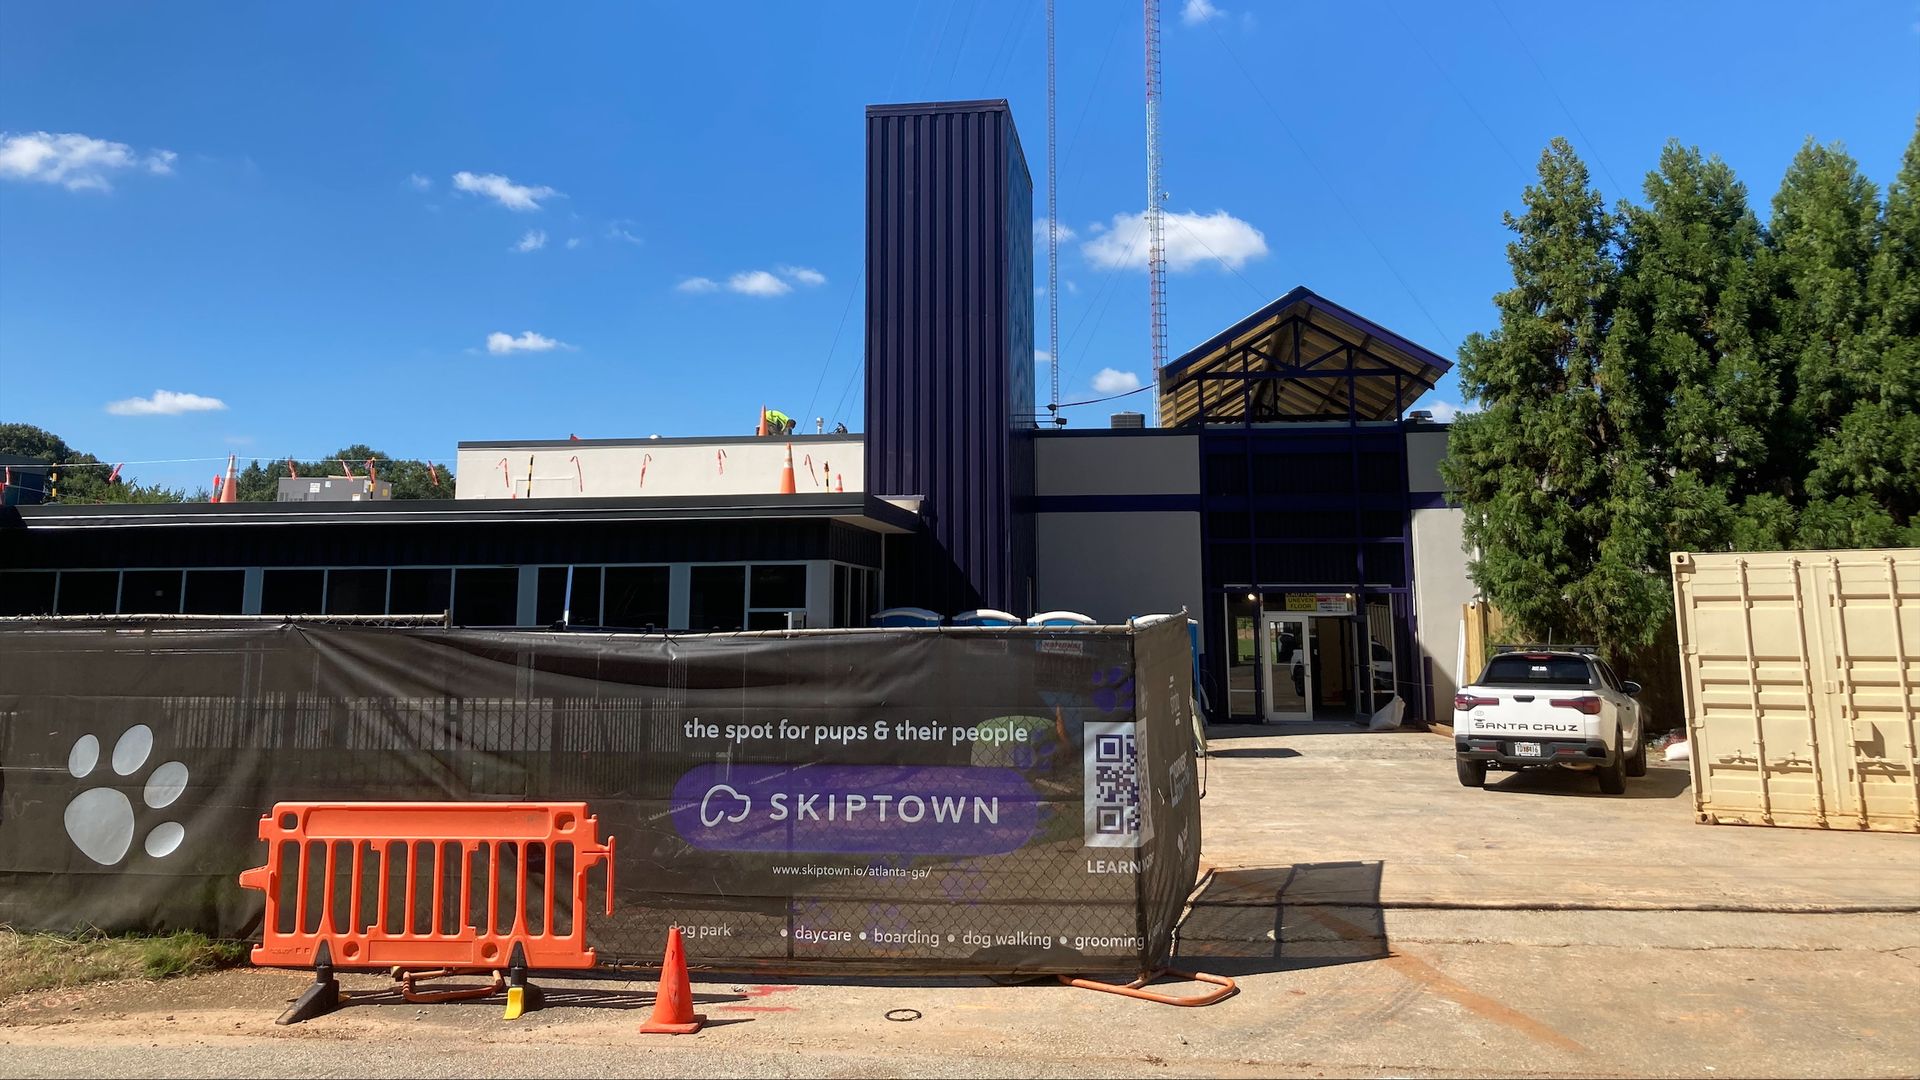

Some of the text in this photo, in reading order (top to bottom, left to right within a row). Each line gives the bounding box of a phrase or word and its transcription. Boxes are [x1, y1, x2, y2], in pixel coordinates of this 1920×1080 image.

[684, 719, 1028, 745] the spot for pups & their people
[1474, 722, 1578, 732] SANTA CRUZ
[769, 793, 999, 824] SKIPTOWN
[772, 864, 932, 880] www.skiptown.io/atlanta-ga/
[1087, 860, 1141, 874] LEARN
[669, 920, 1145, 950] dog park daycare boarding dog walking grooming
